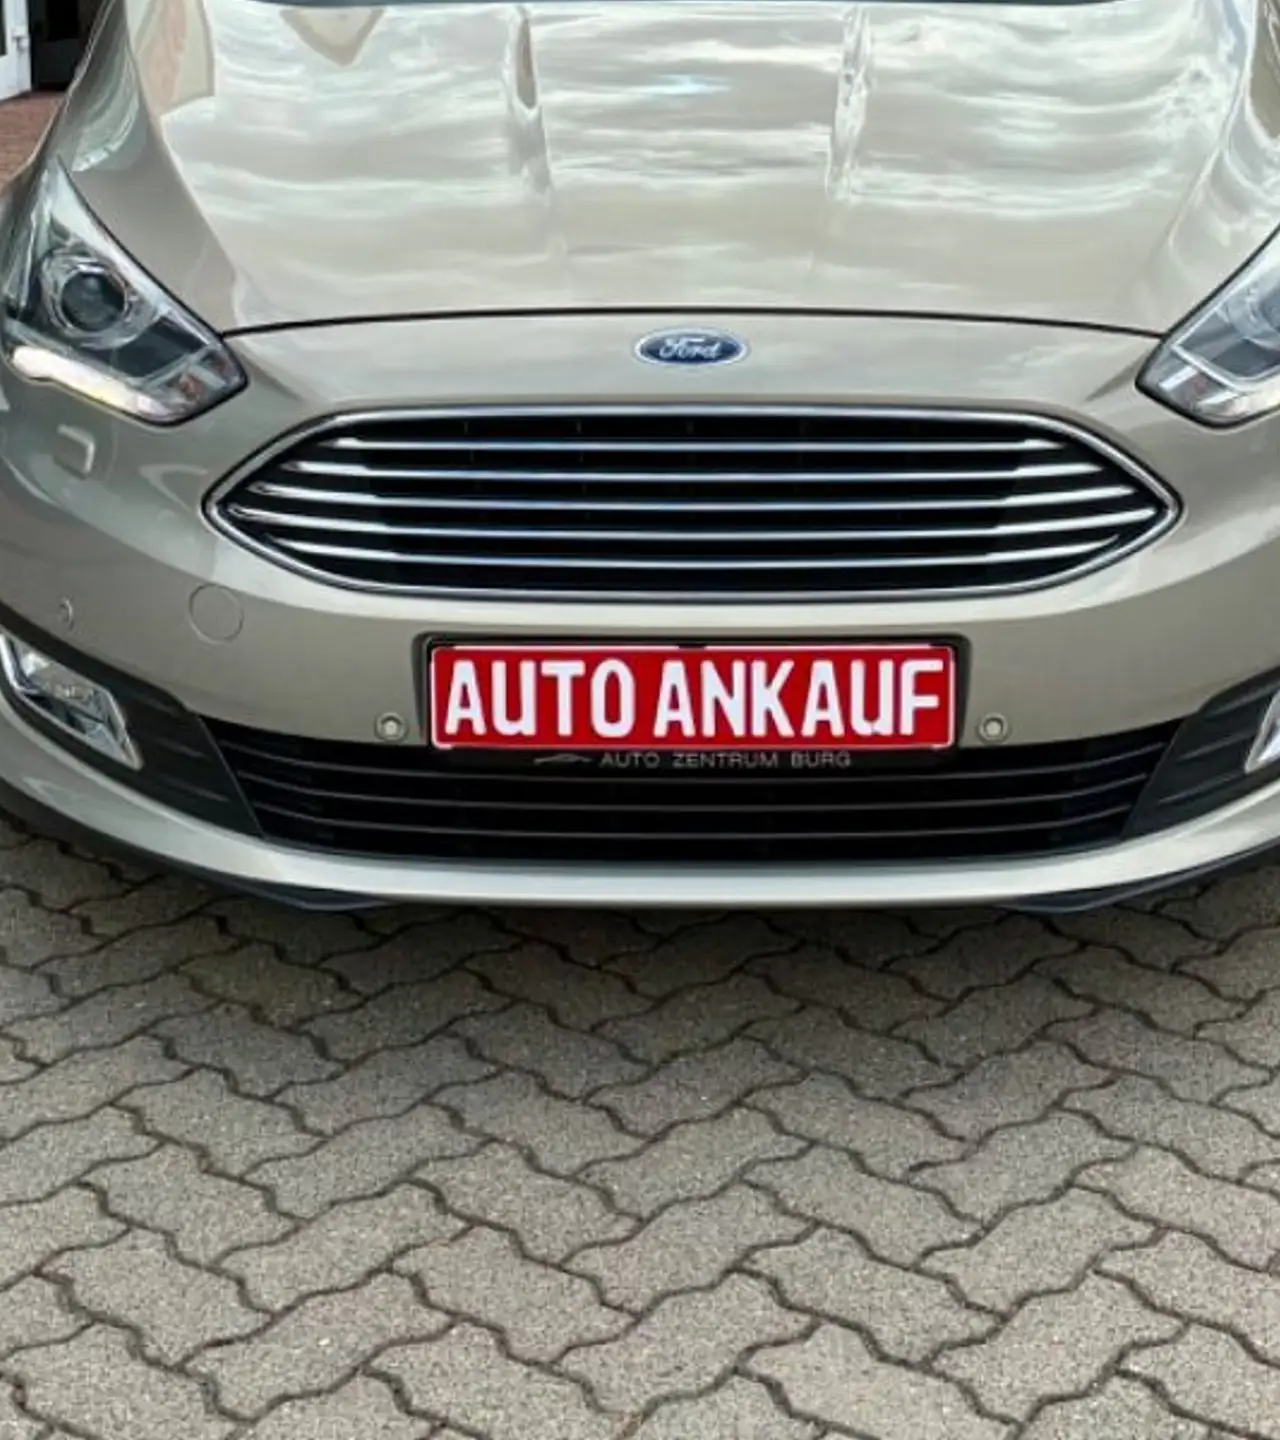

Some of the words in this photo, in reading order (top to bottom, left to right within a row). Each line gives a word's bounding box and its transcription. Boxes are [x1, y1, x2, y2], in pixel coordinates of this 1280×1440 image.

[659, 335, 722, 359] Ford
[444, 659, 637, 737] AUTO
[652, 659, 945, 738] ANKAUF
[599, 751, 661, 769] AUTO
[671, 751, 780, 769] ZENTRUM
[790, 751, 852, 769] BURG
